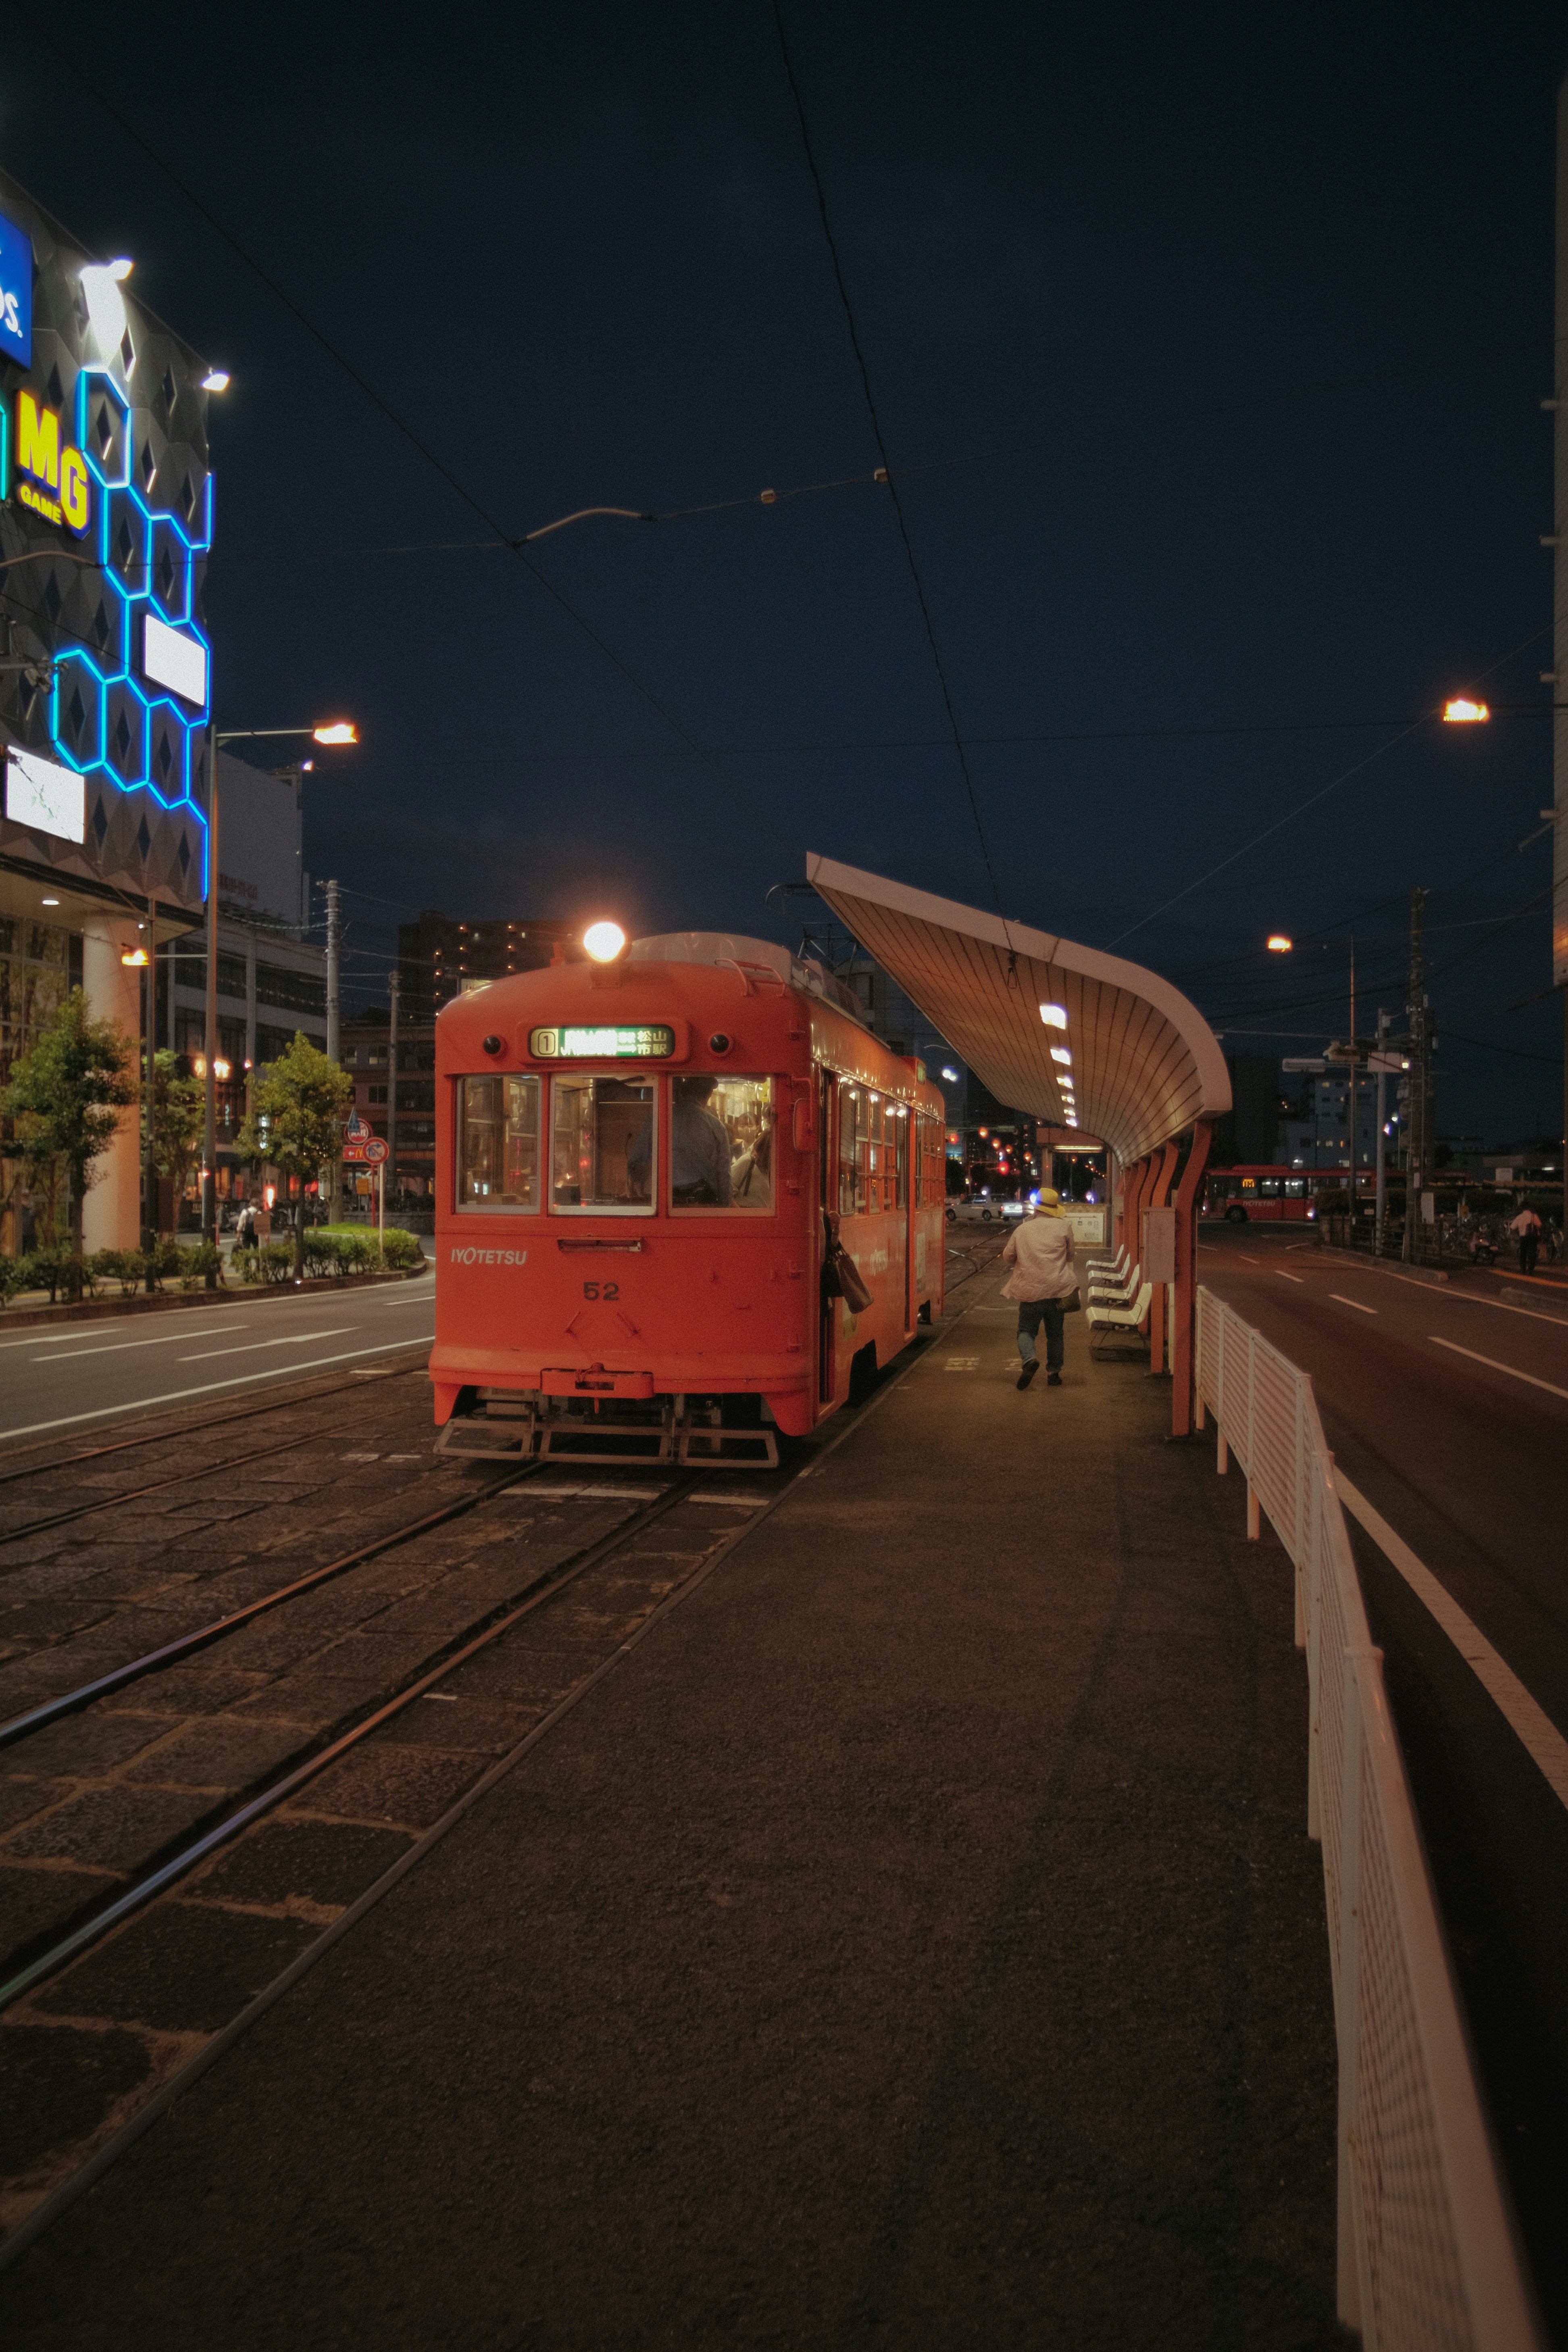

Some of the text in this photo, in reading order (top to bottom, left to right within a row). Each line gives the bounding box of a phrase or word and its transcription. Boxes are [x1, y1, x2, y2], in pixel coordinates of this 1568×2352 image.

[21, 485, 61, 525] GAME
[637, 1030, 666, 1042] 松山
[637, 1043, 666, 1055] 市駅
[451, 1247, 527, 1265] IYOTETSU
[583, 1282, 619, 1301] 52
